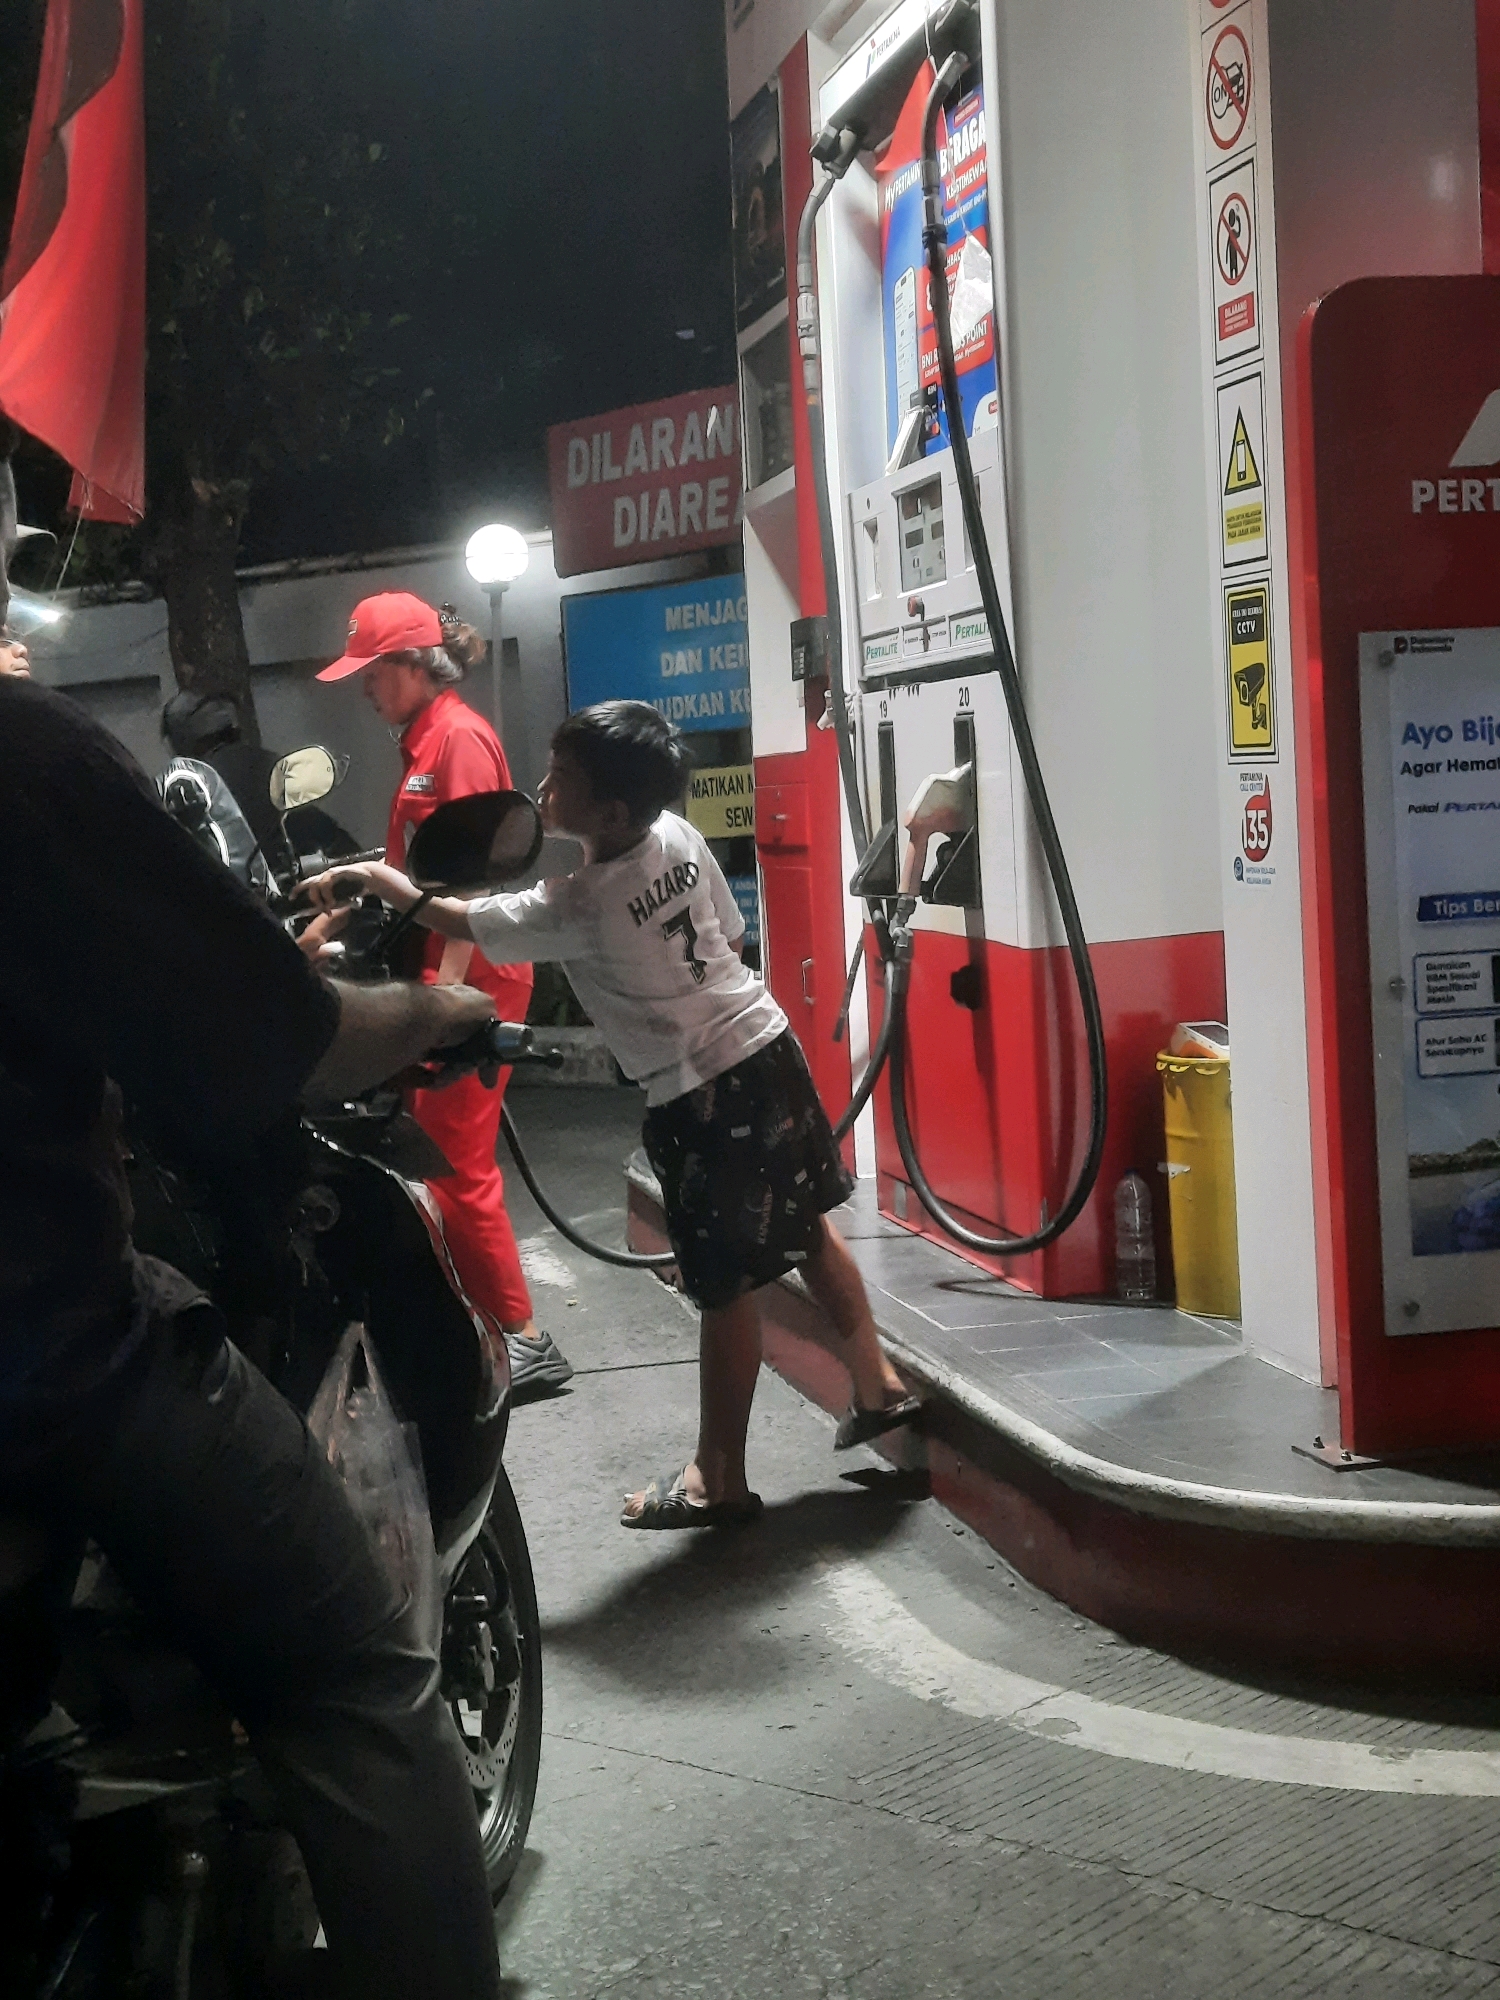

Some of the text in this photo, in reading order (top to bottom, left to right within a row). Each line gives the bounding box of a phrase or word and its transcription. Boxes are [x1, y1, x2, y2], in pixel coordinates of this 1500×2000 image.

[568, 404, 742, 490] DILARAN
[1412, 478, 1500, 514] PERT
[955, 622, 989, 641] PERTALI
[1236, 619, 1256, 635] CCTV
[661, 648, 703, 677] DAN
[866, 641, 898, 661] PERTALITE
[958, 686, 970, 707] 20
[880, 700, 888, 718] 19
[1401, 721, 1453, 750] Ayo
[1400, 760, 1443, 778] Agar
[691, 774, 744, 799] MATIKAN
[726, 806, 753, 829] SEW
[1242, 809, 1269, 851] 135
[627, 861, 700, 928] HAZARD
[1433, 899, 1468, 918] Tips
[661, 904, 708, 984] 7
